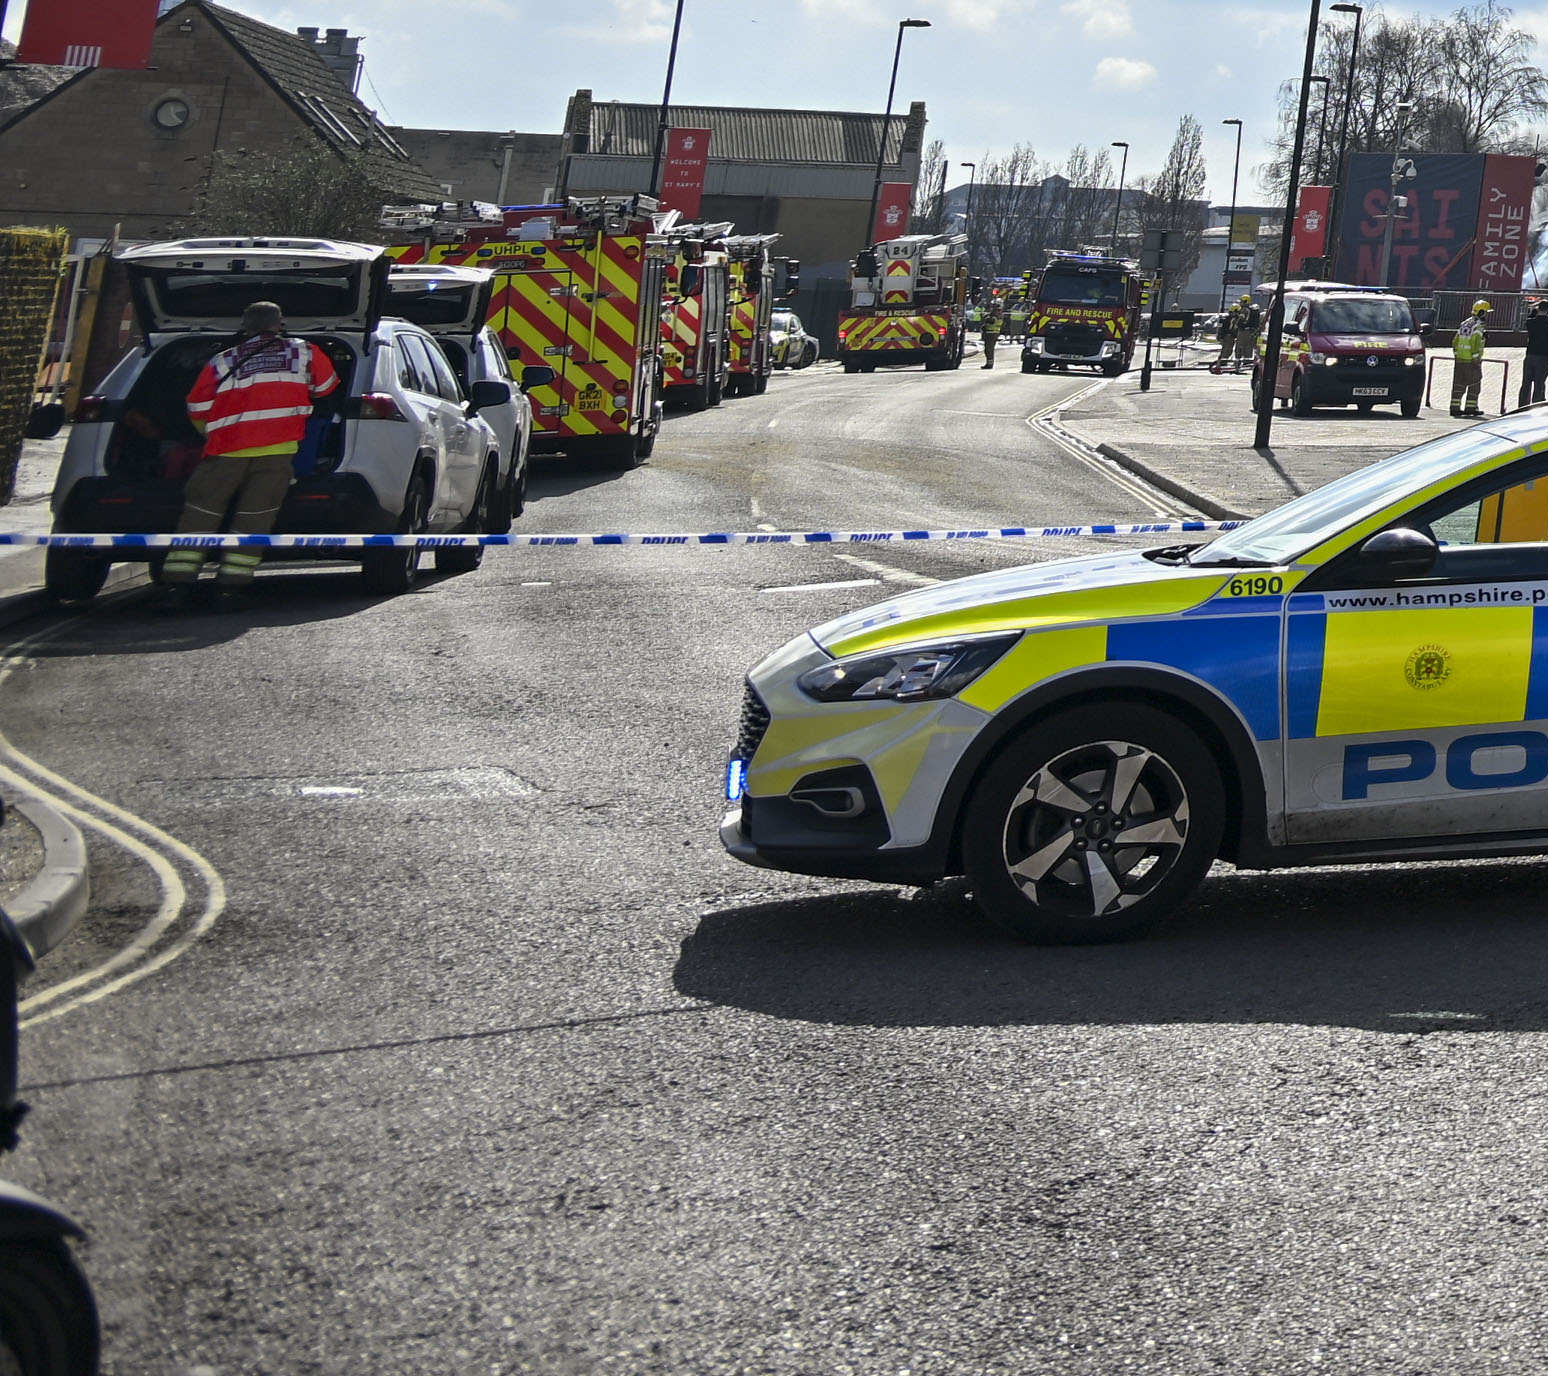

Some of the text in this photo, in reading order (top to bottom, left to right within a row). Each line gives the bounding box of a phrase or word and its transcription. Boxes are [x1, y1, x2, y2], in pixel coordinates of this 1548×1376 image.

[1360, 188, 1461, 240] SAI
[1479, 187, 1507, 293] FAMILY
[1501, 205, 1524, 278] ZONE
[494, 245, 529, 255] UHPL
[893, 246, 908, 255] 24
[1046, 307, 1114, 319] FIRE AND RESCUE
[579, 400, 601, 410] BXH
[1230, 576, 1283, 597] 6190
